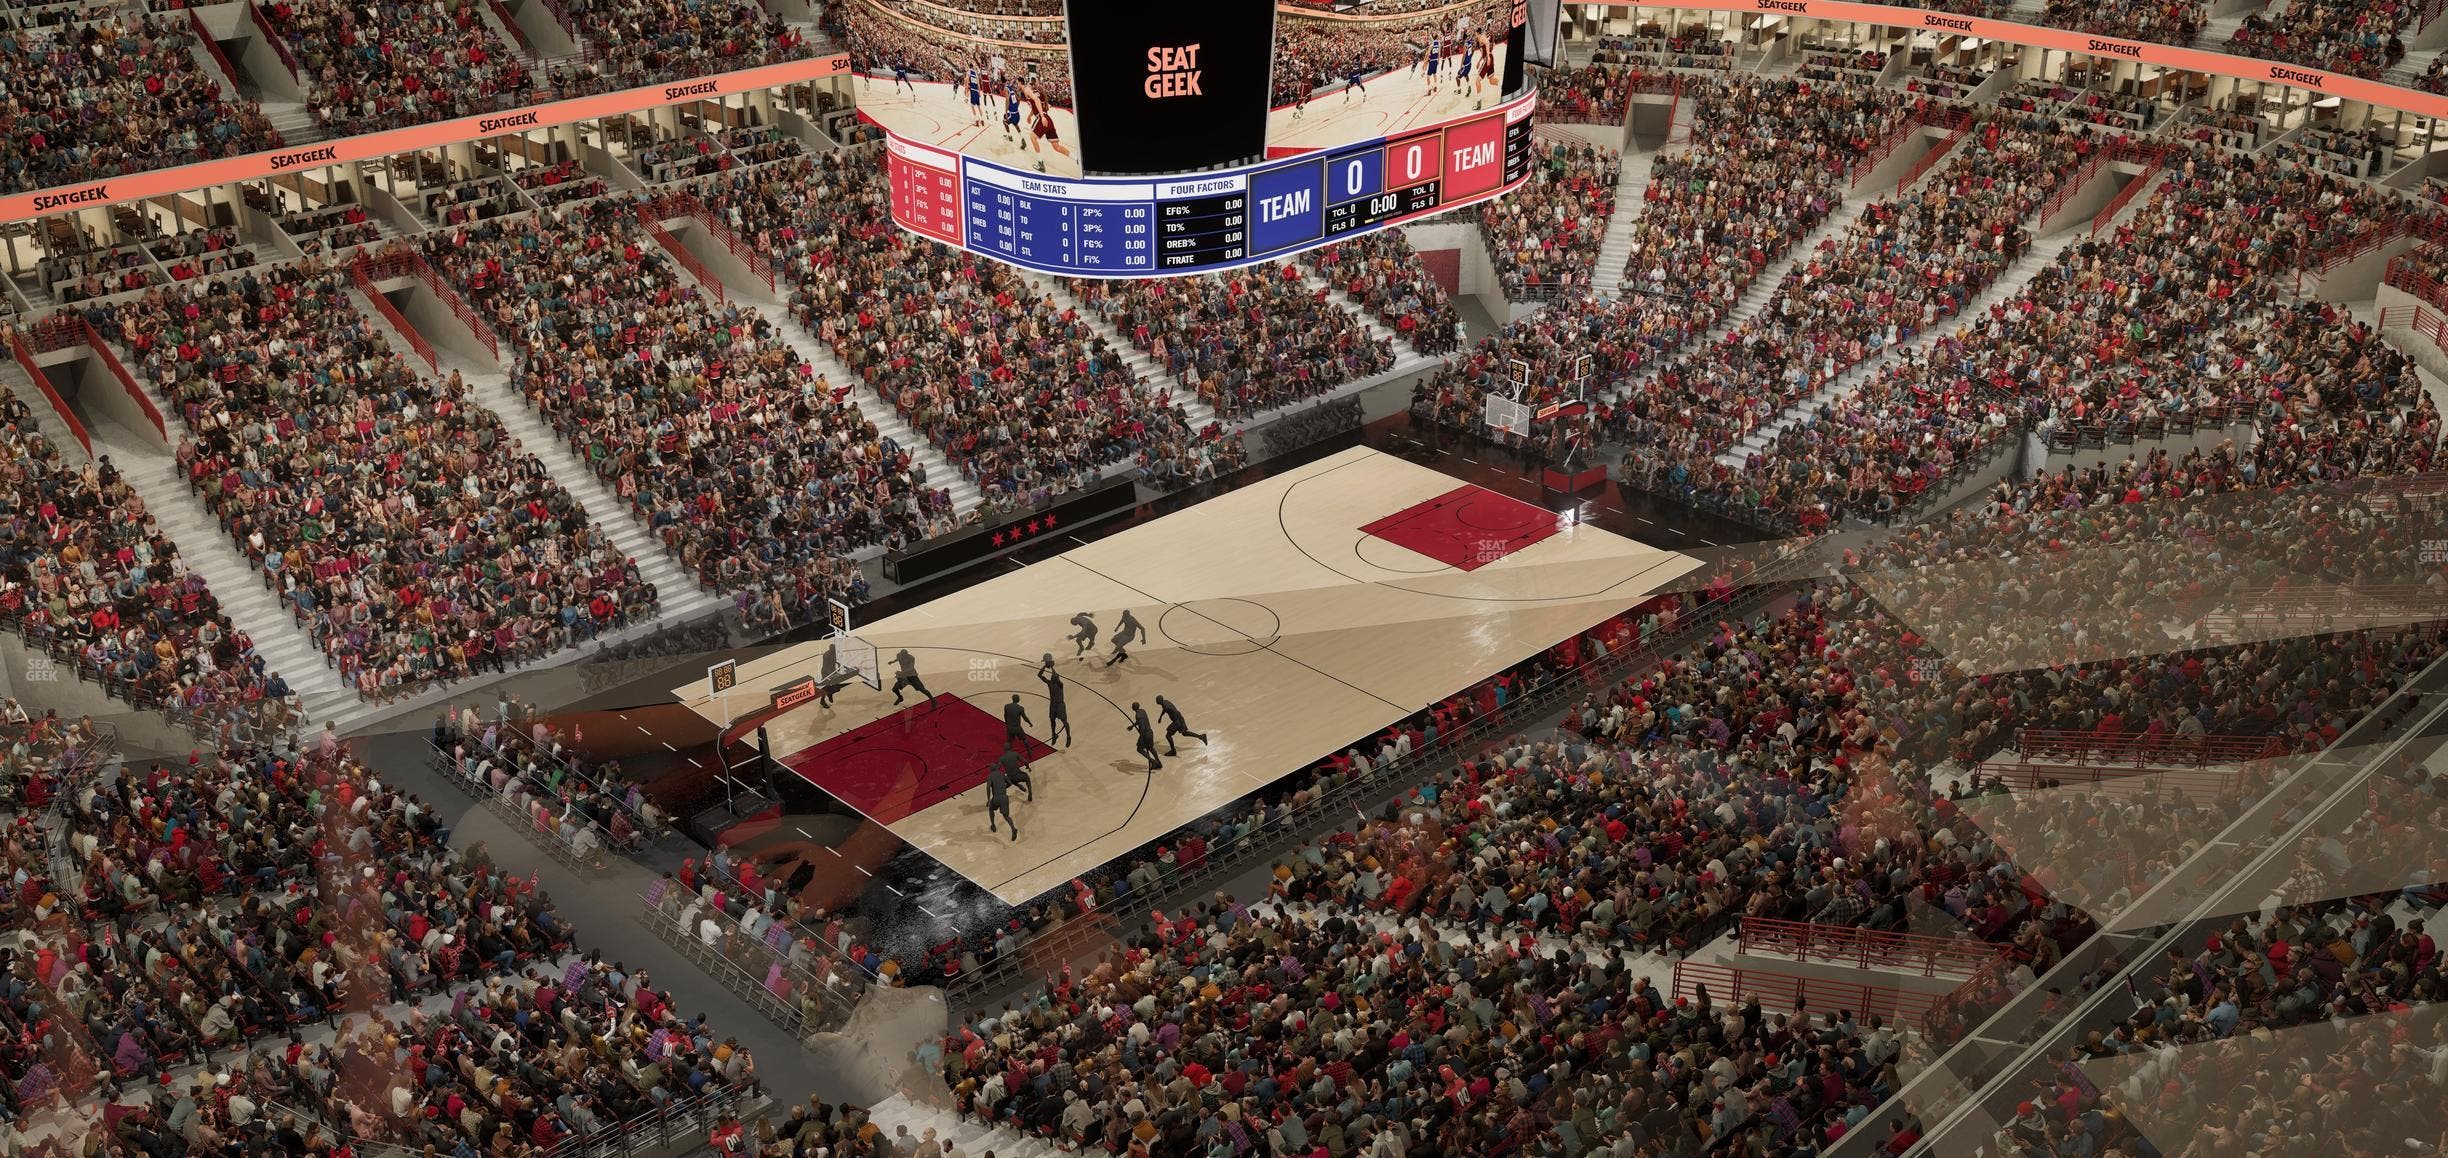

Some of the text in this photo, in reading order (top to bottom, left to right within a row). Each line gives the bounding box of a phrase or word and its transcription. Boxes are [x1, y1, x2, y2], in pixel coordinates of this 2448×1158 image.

[1925, 14, 1972, 32] SEATGEEK
[2089, 39, 2141, 58] SEATGEEK
[1148, 43, 1200, 72] SEAT
[1144, 70, 1202, 99] GEEK
[2270, 67, 2323, 88] SEATGEEK
[665, 81, 717, 100] SEATGEEK
[480, 112, 538, 132] SEATGEEK
[270, 146, 336, 169] SEATGEEK
[1406, 145, 1422, 180] 0
[1453, 140, 1495, 173] TEAM
[939, 177, 952, 188] 0.00
[1347, 160, 1363, 195] 0
[1021, 180, 1067, 195] TEAM STATS
[1170, 180, 1234, 195] FOUR FACTORS
[1412, 182, 1434, 196] TOL 0
[33, 186, 109, 211] SEATGEEK
[940, 192, 952, 203] 0.00
[971, 186, 1010, 206] AST 0.00
[1412, 196, 1434, 210] FLS 0
[940, 207, 954, 218] 0.00
[1020, 200, 1068, 216] BLK 0
[1166, 198, 1242, 216] EFG% 0.00
[1260, 188, 1310, 223] TEAM
[1332, 204, 1356, 218] TOL 0
[1370, 194, 1396, 215] 0:00
[998, 210, 1012, 220] 0.00
[1082, 208, 1145, 218] 2P% 0.00
[942, 222, 954, 233] 0.00
[998, 224, 1012, 236] 0.00
[1020, 216, 1068, 232] TO 0
[1083, 224, 1145, 234] 3P% 0.00
[1166, 215, 1242, 232] TO% 0.00
[1332, 218, 1356, 232] FLS 0
[973, 232, 1012, 252] STL 0.00
[1020, 231, 1068, 247] POT 0
[1084, 240, 1146, 250] FG% 0.00
[1166, 231, 1242, 248] OREB% 0.00
[1022, 246, 1068, 262] STL 0
[1126, 256, 1146, 264] 0.00
[1166, 248, 1242, 266] FTRATE 0.00
[1512, 370, 1522, 382] 88
[1580, 366, 1589, 377] 88
[832, 613, 844, 628] 88
[718, 674, 730, 690] 88
[780, 690, 811, 706] SEATGEEK
[1084, 894, 1096, 910] 00
[1394, 950, 1406, 966] 00
[1530, 942, 1541, 960] 00
[663, 1042, 672, 1058] 00
[1456, 1087, 1470, 1107] 00
